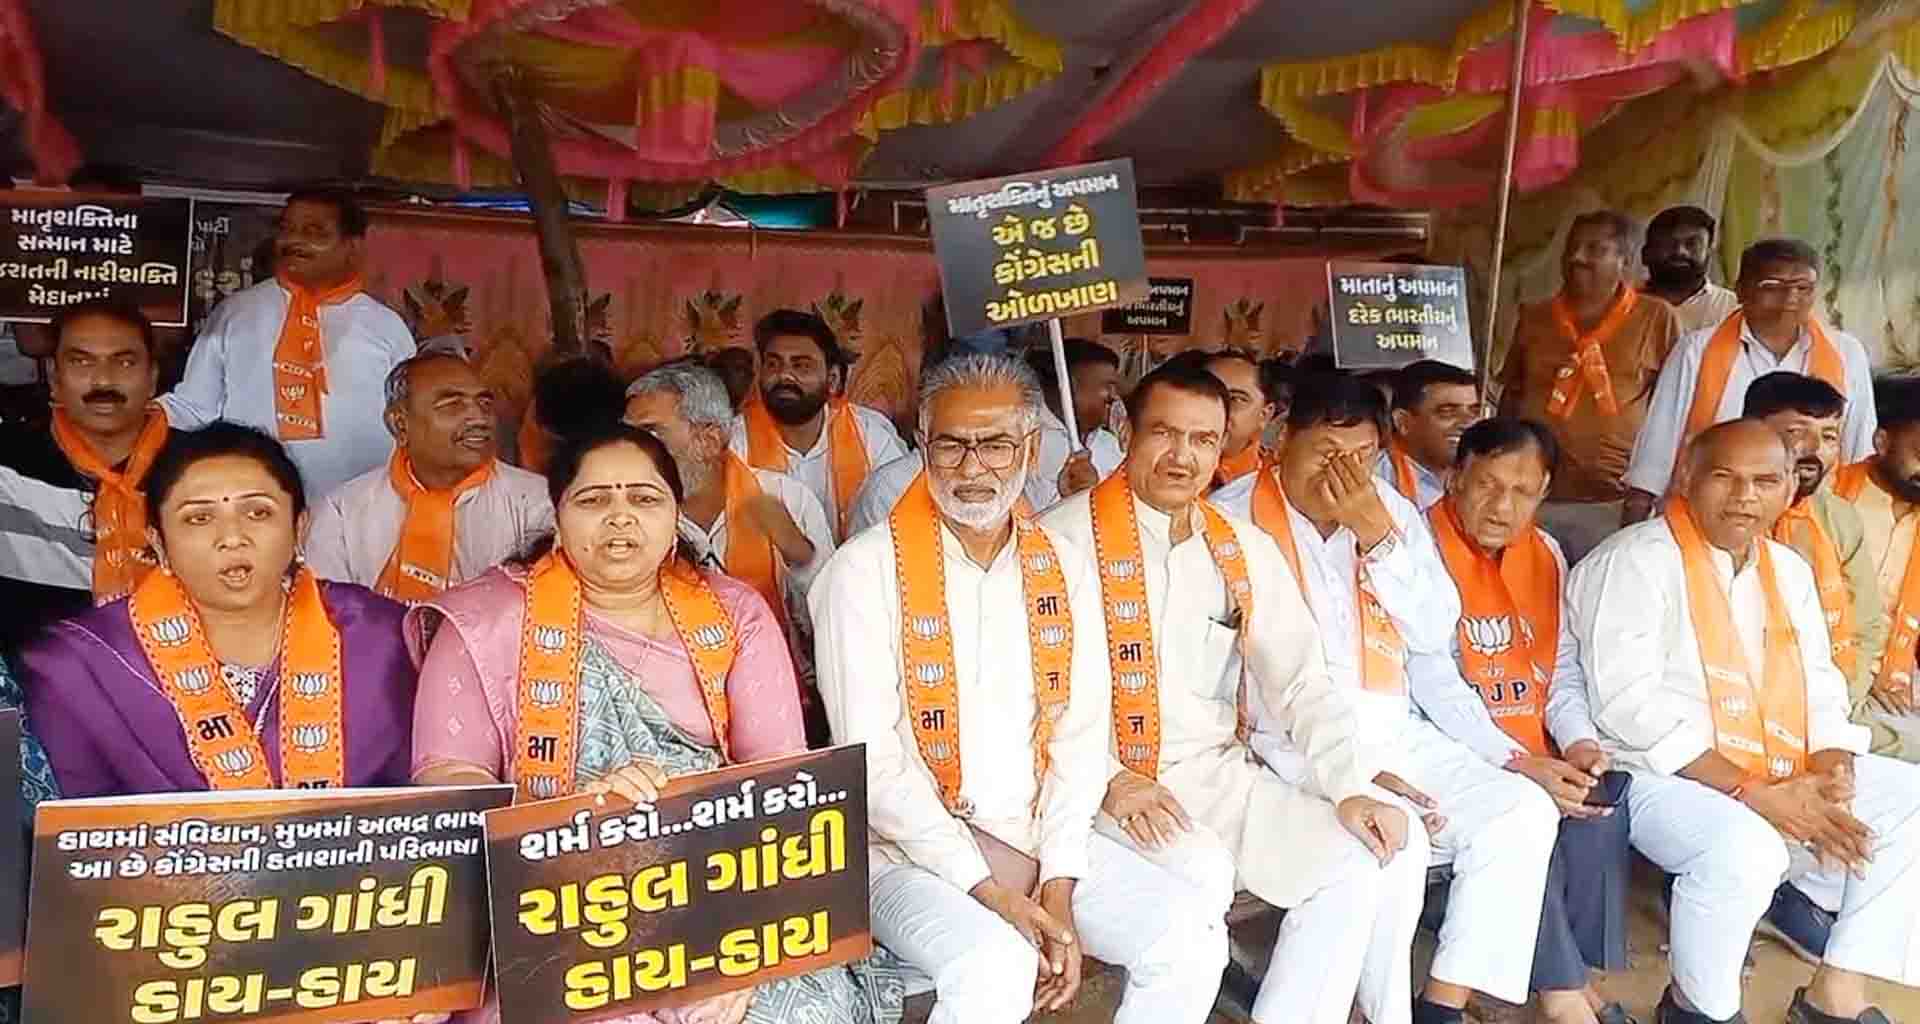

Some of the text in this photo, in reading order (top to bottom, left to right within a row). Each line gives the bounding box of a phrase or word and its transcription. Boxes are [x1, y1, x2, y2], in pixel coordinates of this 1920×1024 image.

[1053, 173, 1120, 196] અપમાન
[11, 204, 138, 232] માતૃશક્તિના
[992, 204, 1091, 245] એ જ છે
[17, 234, 133, 254] સન્માન માટે
[74, 261, 178, 285] નારીશક્તિ
[994, 238, 1100, 285] કોંગ્રેસની
[985, 280, 1118, 321] ઓળખાણ
[1340, 273, 1458, 301] માતાનું અપમાન
[1348, 302, 1457, 334] દરેક ભારતીયનું
[1376, 333, 1438, 350] અપમાન
[1036, 595, 1060, 617] भा
[1118, 641, 1143, 663] भा
[196, 714, 235, 742] भा
[921, 707, 946, 732] भा
[1127, 715, 1145, 737] ज
[527, 735, 558, 763] भा
[57, 823, 149, 852] હાથમાં
[153, 819, 268, 846] સંવિધાન,
[274, 815, 353, 848] મુખમાં
[356, 814, 430, 835] અભદ્ર
[520, 809, 590, 862] શર્મ
[69, 836, 479, 879] આ છે કોંગ્રેસની હતાશાની પરિભાષા
[517, 808, 847, 949] રાહુલ ગાંધી
[95, 865, 449, 969] રાહુલ ગાંધી
[563, 909, 832, 1013] હાય-હાય
[130, 957, 417, 1024] હાય-હાય
